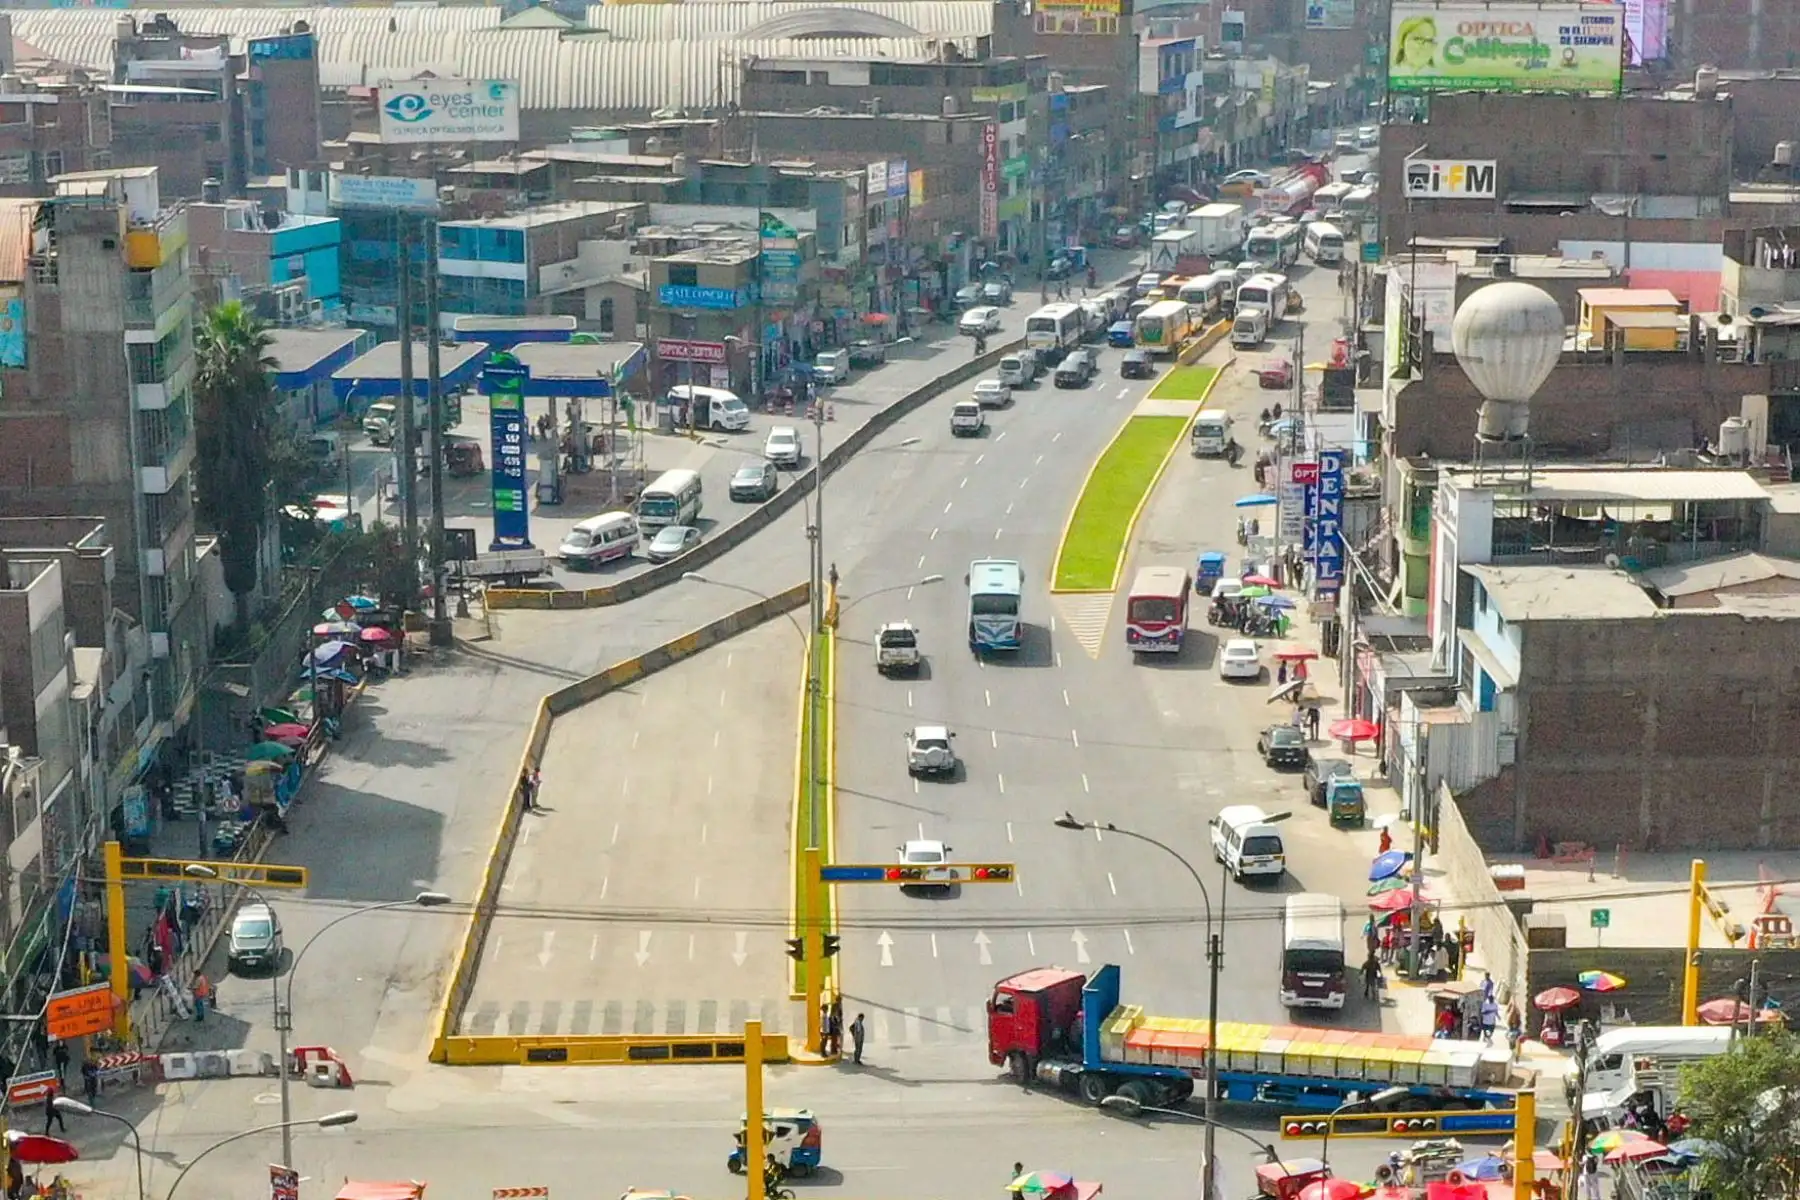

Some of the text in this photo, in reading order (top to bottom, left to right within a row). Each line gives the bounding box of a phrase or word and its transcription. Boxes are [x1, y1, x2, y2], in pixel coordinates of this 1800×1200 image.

[430, 91, 473, 109] eyes
[447, 103, 505, 119] center
[985, 124, 996, 190] NOTARIO
[1320, 456, 1340, 578] DENTAL
